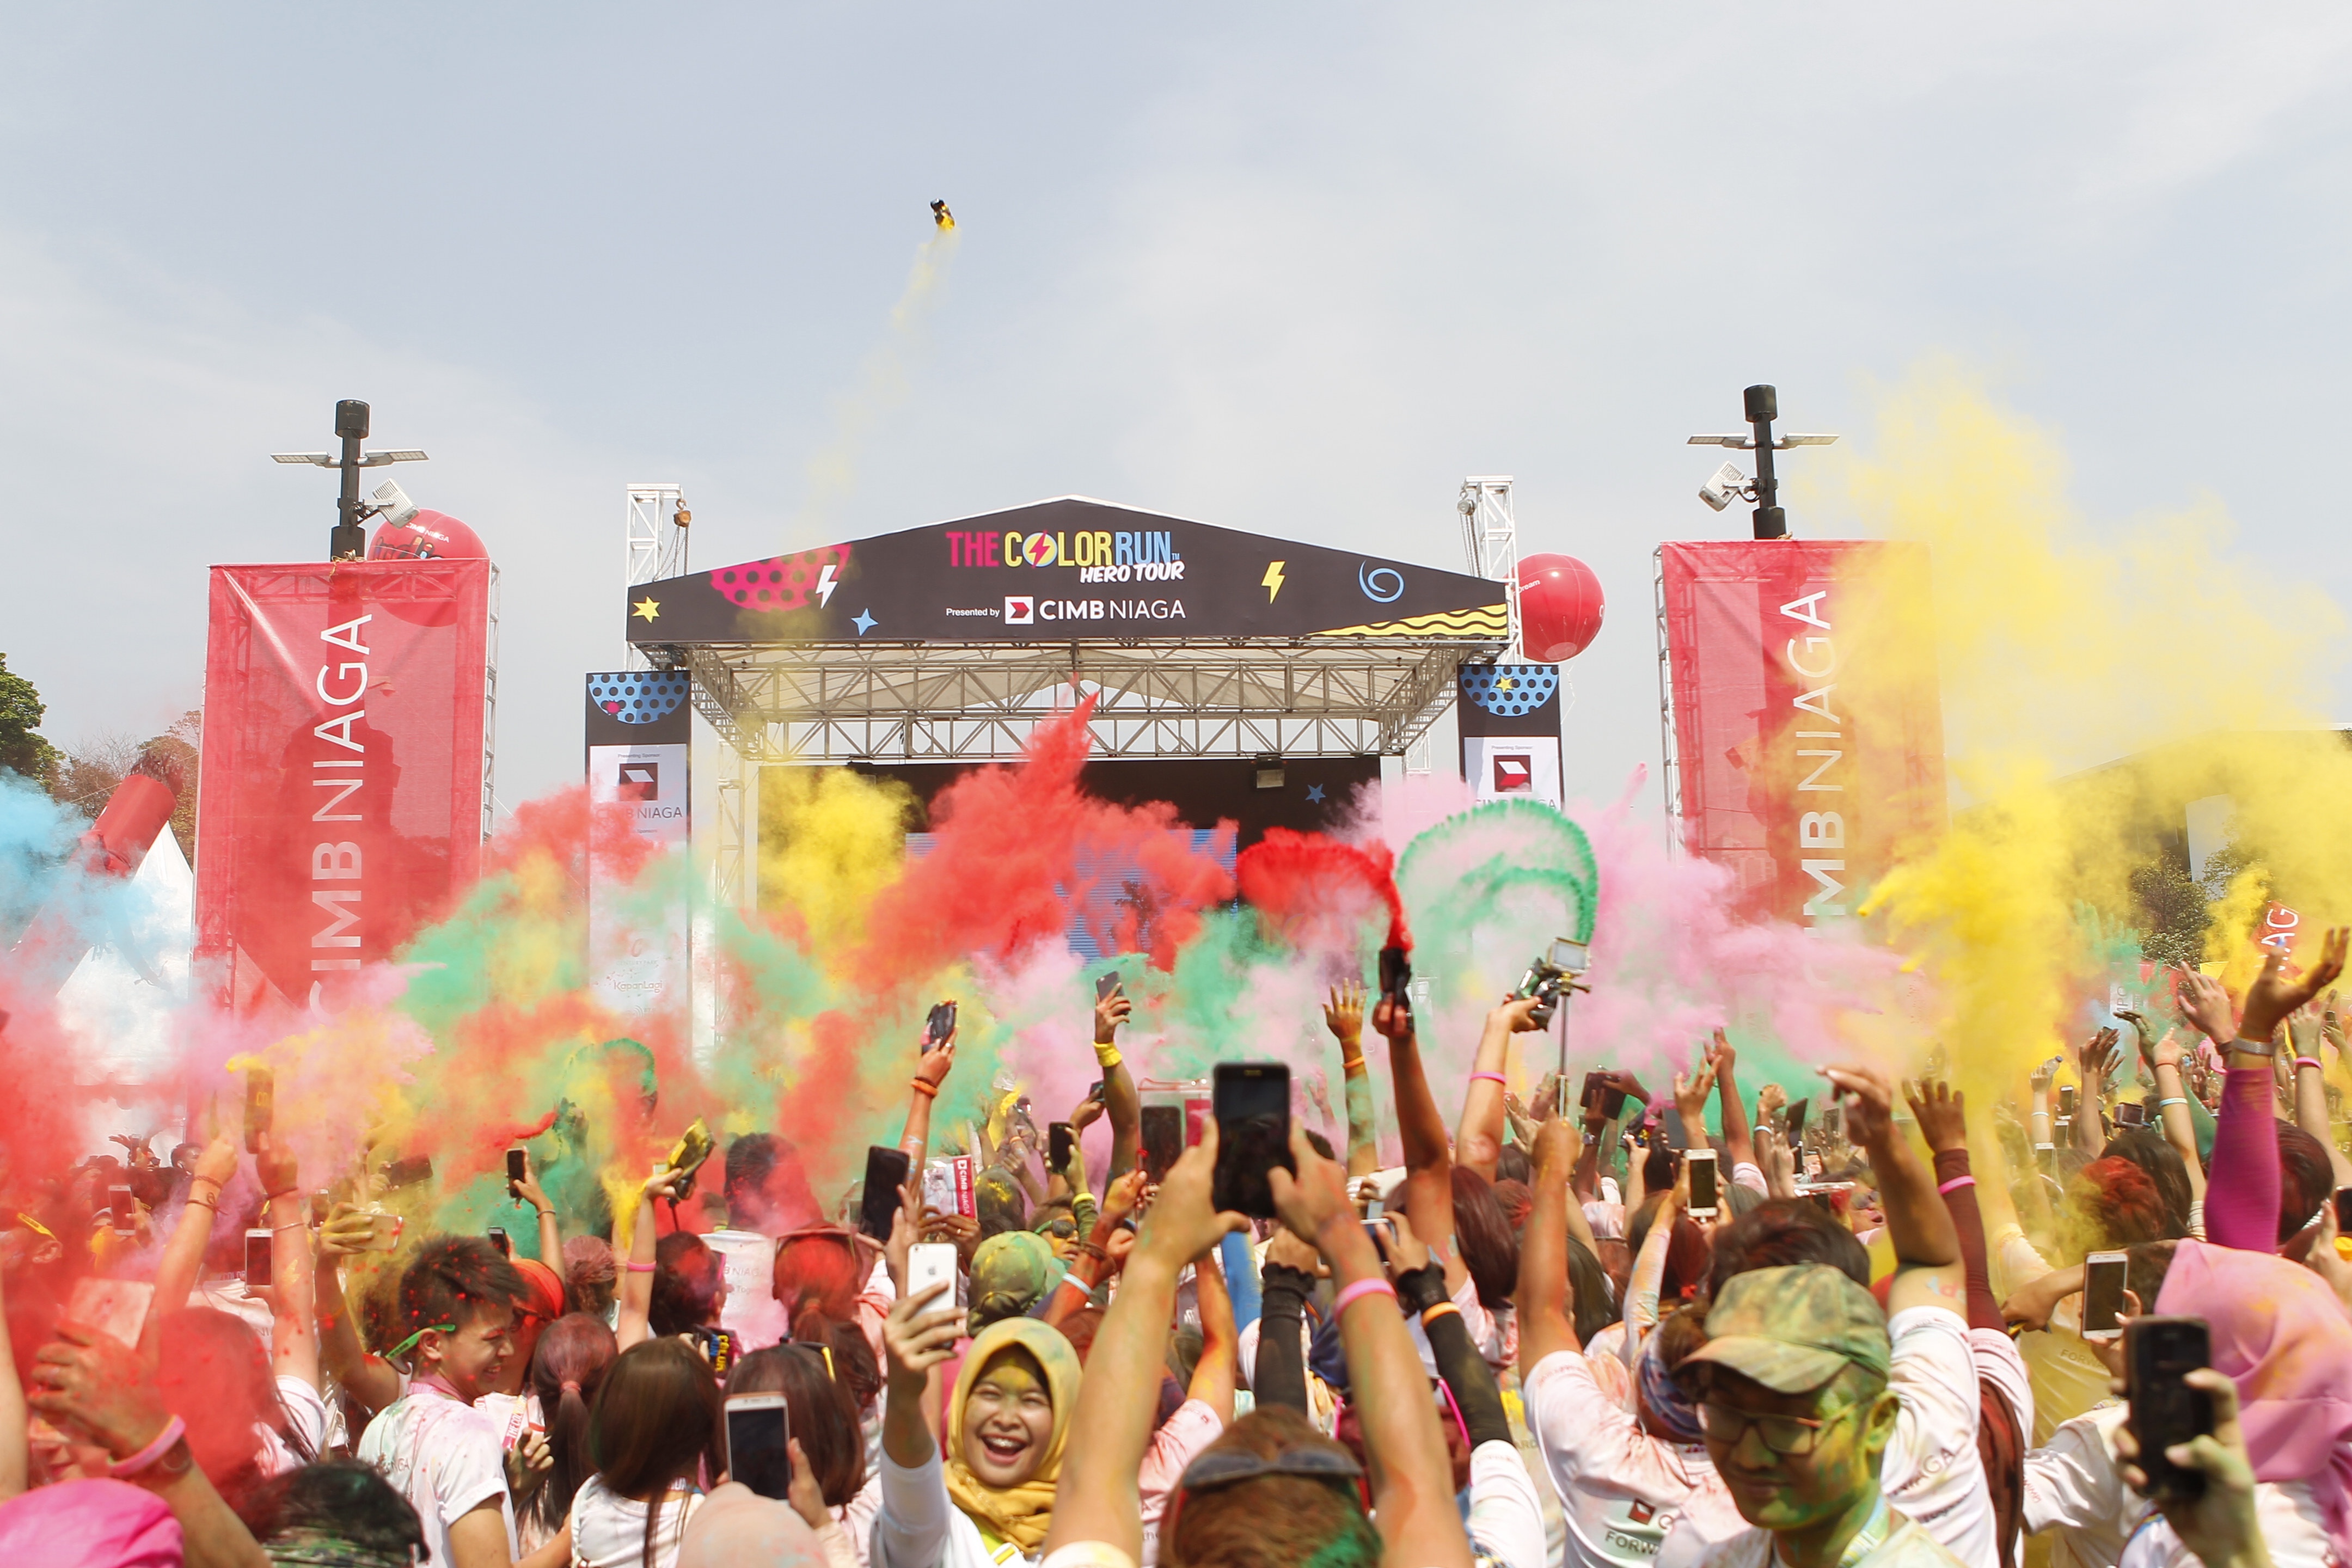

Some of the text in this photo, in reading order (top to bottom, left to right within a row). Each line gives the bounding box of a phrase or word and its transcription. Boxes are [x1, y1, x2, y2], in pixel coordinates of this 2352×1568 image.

[946, 531, 999, 567] THE
[1004, 530, 1113, 567] COLOR
[1114, 531, 1171, 566] RUN
[1080, 560, 1186, 584] HERO TOUR
[946, 608, 1000, 618] Presented by
[1039, 599, 1186, 621] CIMB NIAGA
[1780, 590, 1844, 792] NIAGA
[312, 614, 372, 822] NIAGA
[637, 806, 682, 819] NIAGA
[614, 980, 663, 994] KapanLagi
[959, 1169, 971, 1215] CIMB NIAGA
